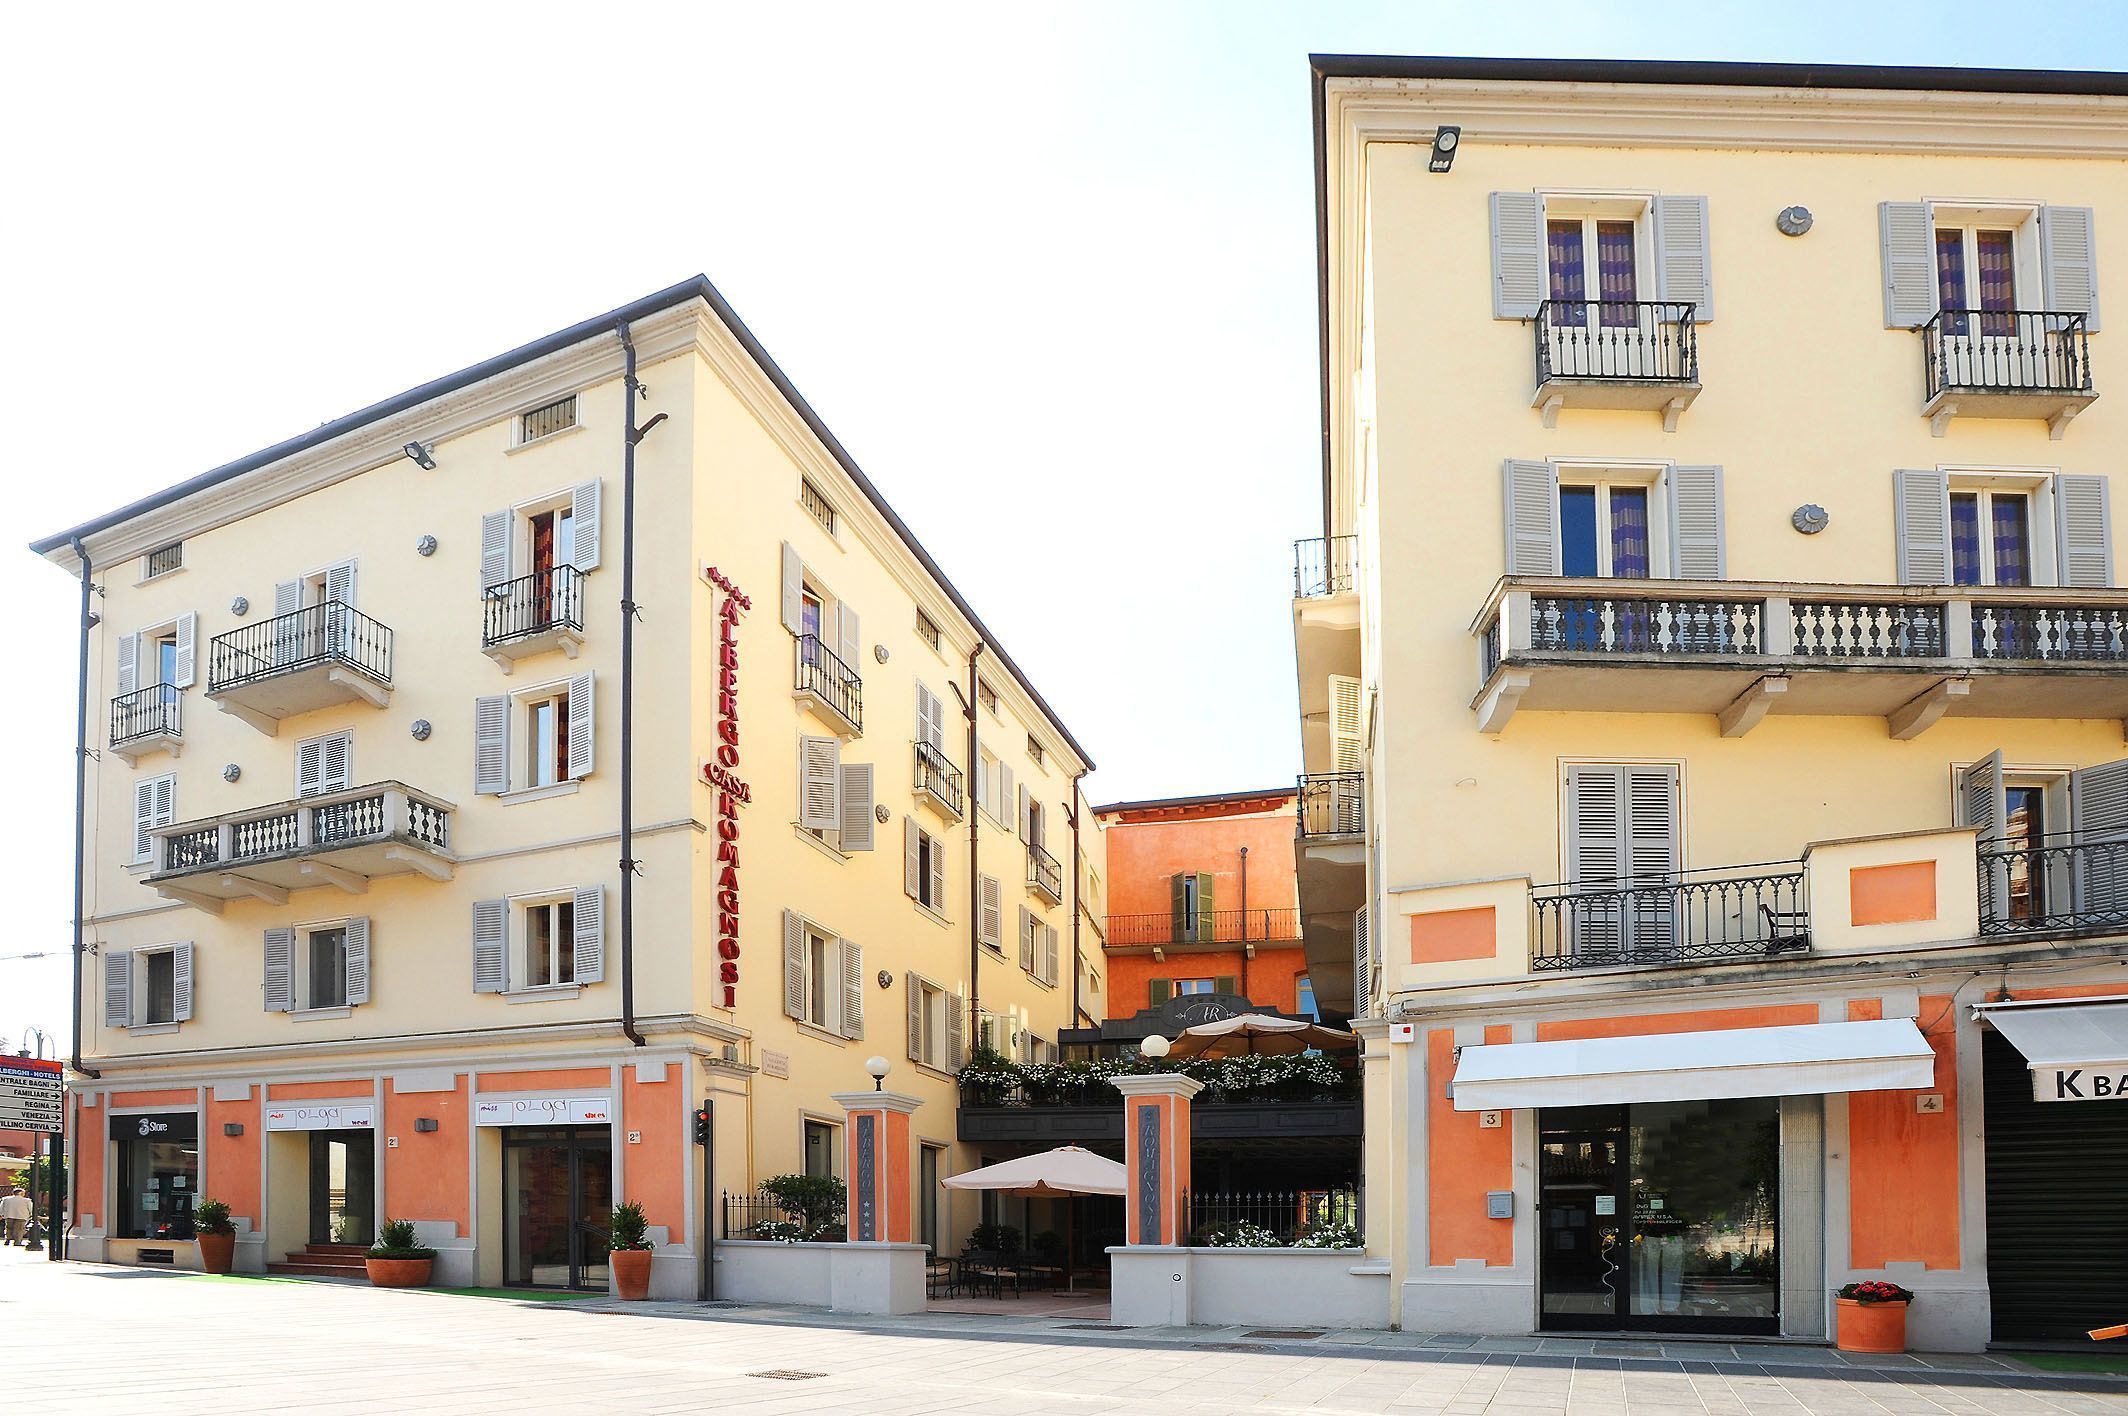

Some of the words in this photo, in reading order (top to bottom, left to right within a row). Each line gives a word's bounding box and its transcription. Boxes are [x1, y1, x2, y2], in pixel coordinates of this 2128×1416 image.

[717, 598, 740, 768] ALBERGO
[704, 762, 752, 803] CASA
[717, 791, 741, 1008] ROMAGNOSI
[34, 1071, 61, 1080] HOTELS
[29, 1080, 50, 1088] BAGNI
[2056, 1070, 2085, 1099] K
[13, 1089, 50, 1099] FAMILIARE
[25, 1101, 50, 1109] REGINA
[21, 1112, 50, 1120] VENEZIA
[1486, 1114, 1496, 1125] 3
[25, 1123, 50, 1131] CERVIA
[139, 1118, 149, 1136] 3
[150, 1121, 168, 1131] Store
